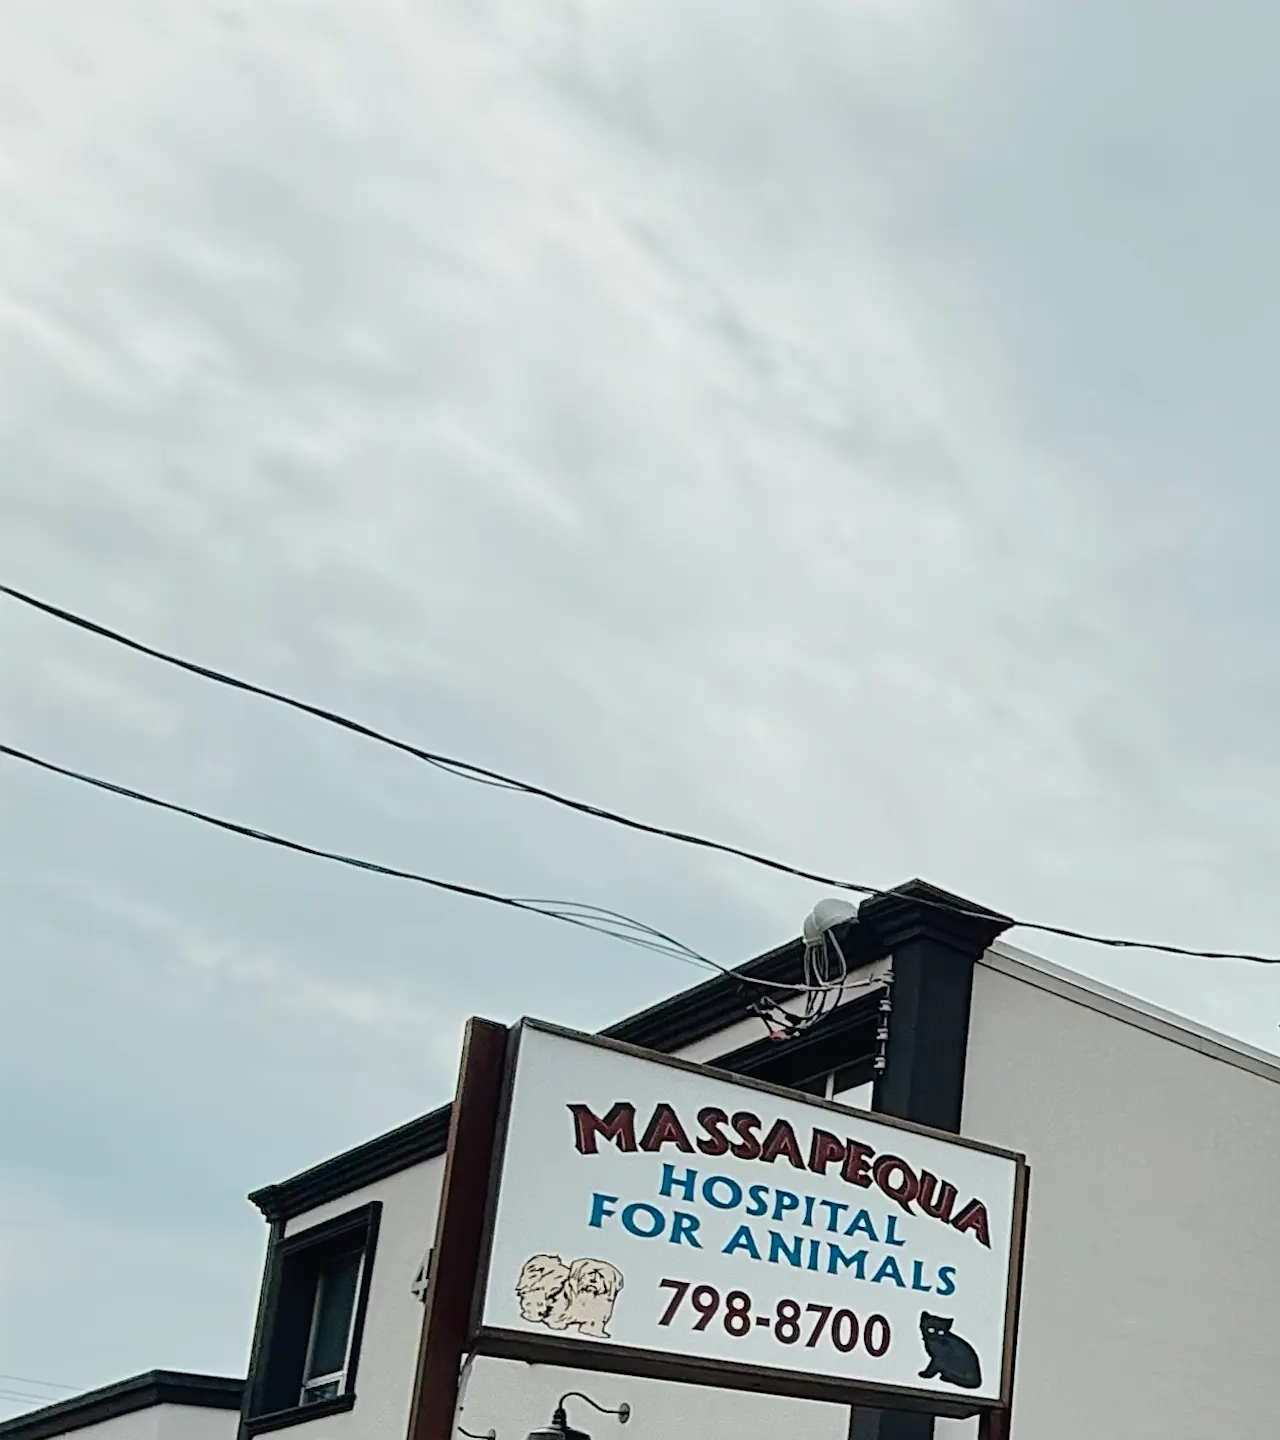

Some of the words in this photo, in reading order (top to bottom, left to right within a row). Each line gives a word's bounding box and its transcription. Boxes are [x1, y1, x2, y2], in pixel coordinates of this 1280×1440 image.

[566, 1102, 991, 1249] MASSAPEQUA
[659, 1163, 906, 1247] HOSPITAL
[588, 1192, 703, 1249] FOR
[721, 1225, 956, 1296] ANIMALS
[658, 1278, 891, 1358] 798-8700
